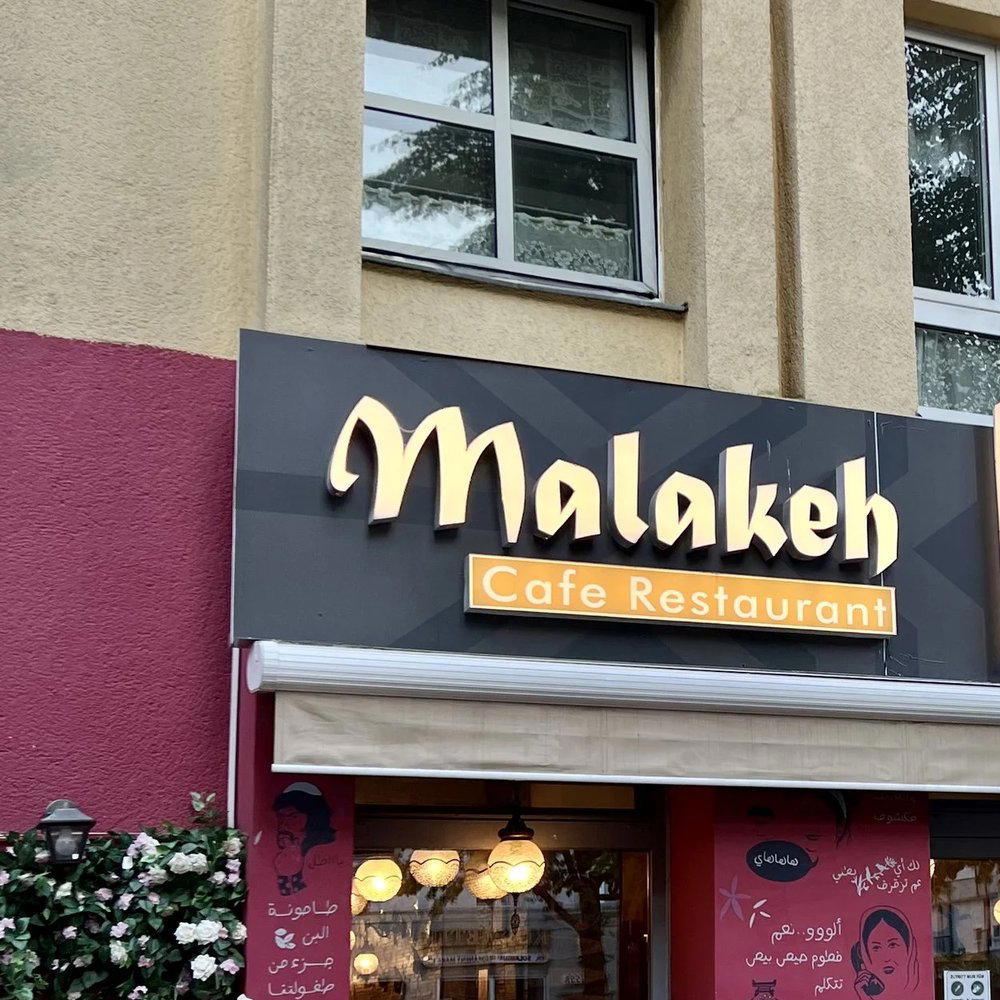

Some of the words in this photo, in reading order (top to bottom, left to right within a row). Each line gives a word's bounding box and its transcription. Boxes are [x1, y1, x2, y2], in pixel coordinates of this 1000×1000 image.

[330, 395, 898, 577] Malakeh
[482, 566, 607, 609] Cafe
[630, 576, 888, 628] Restaurant
